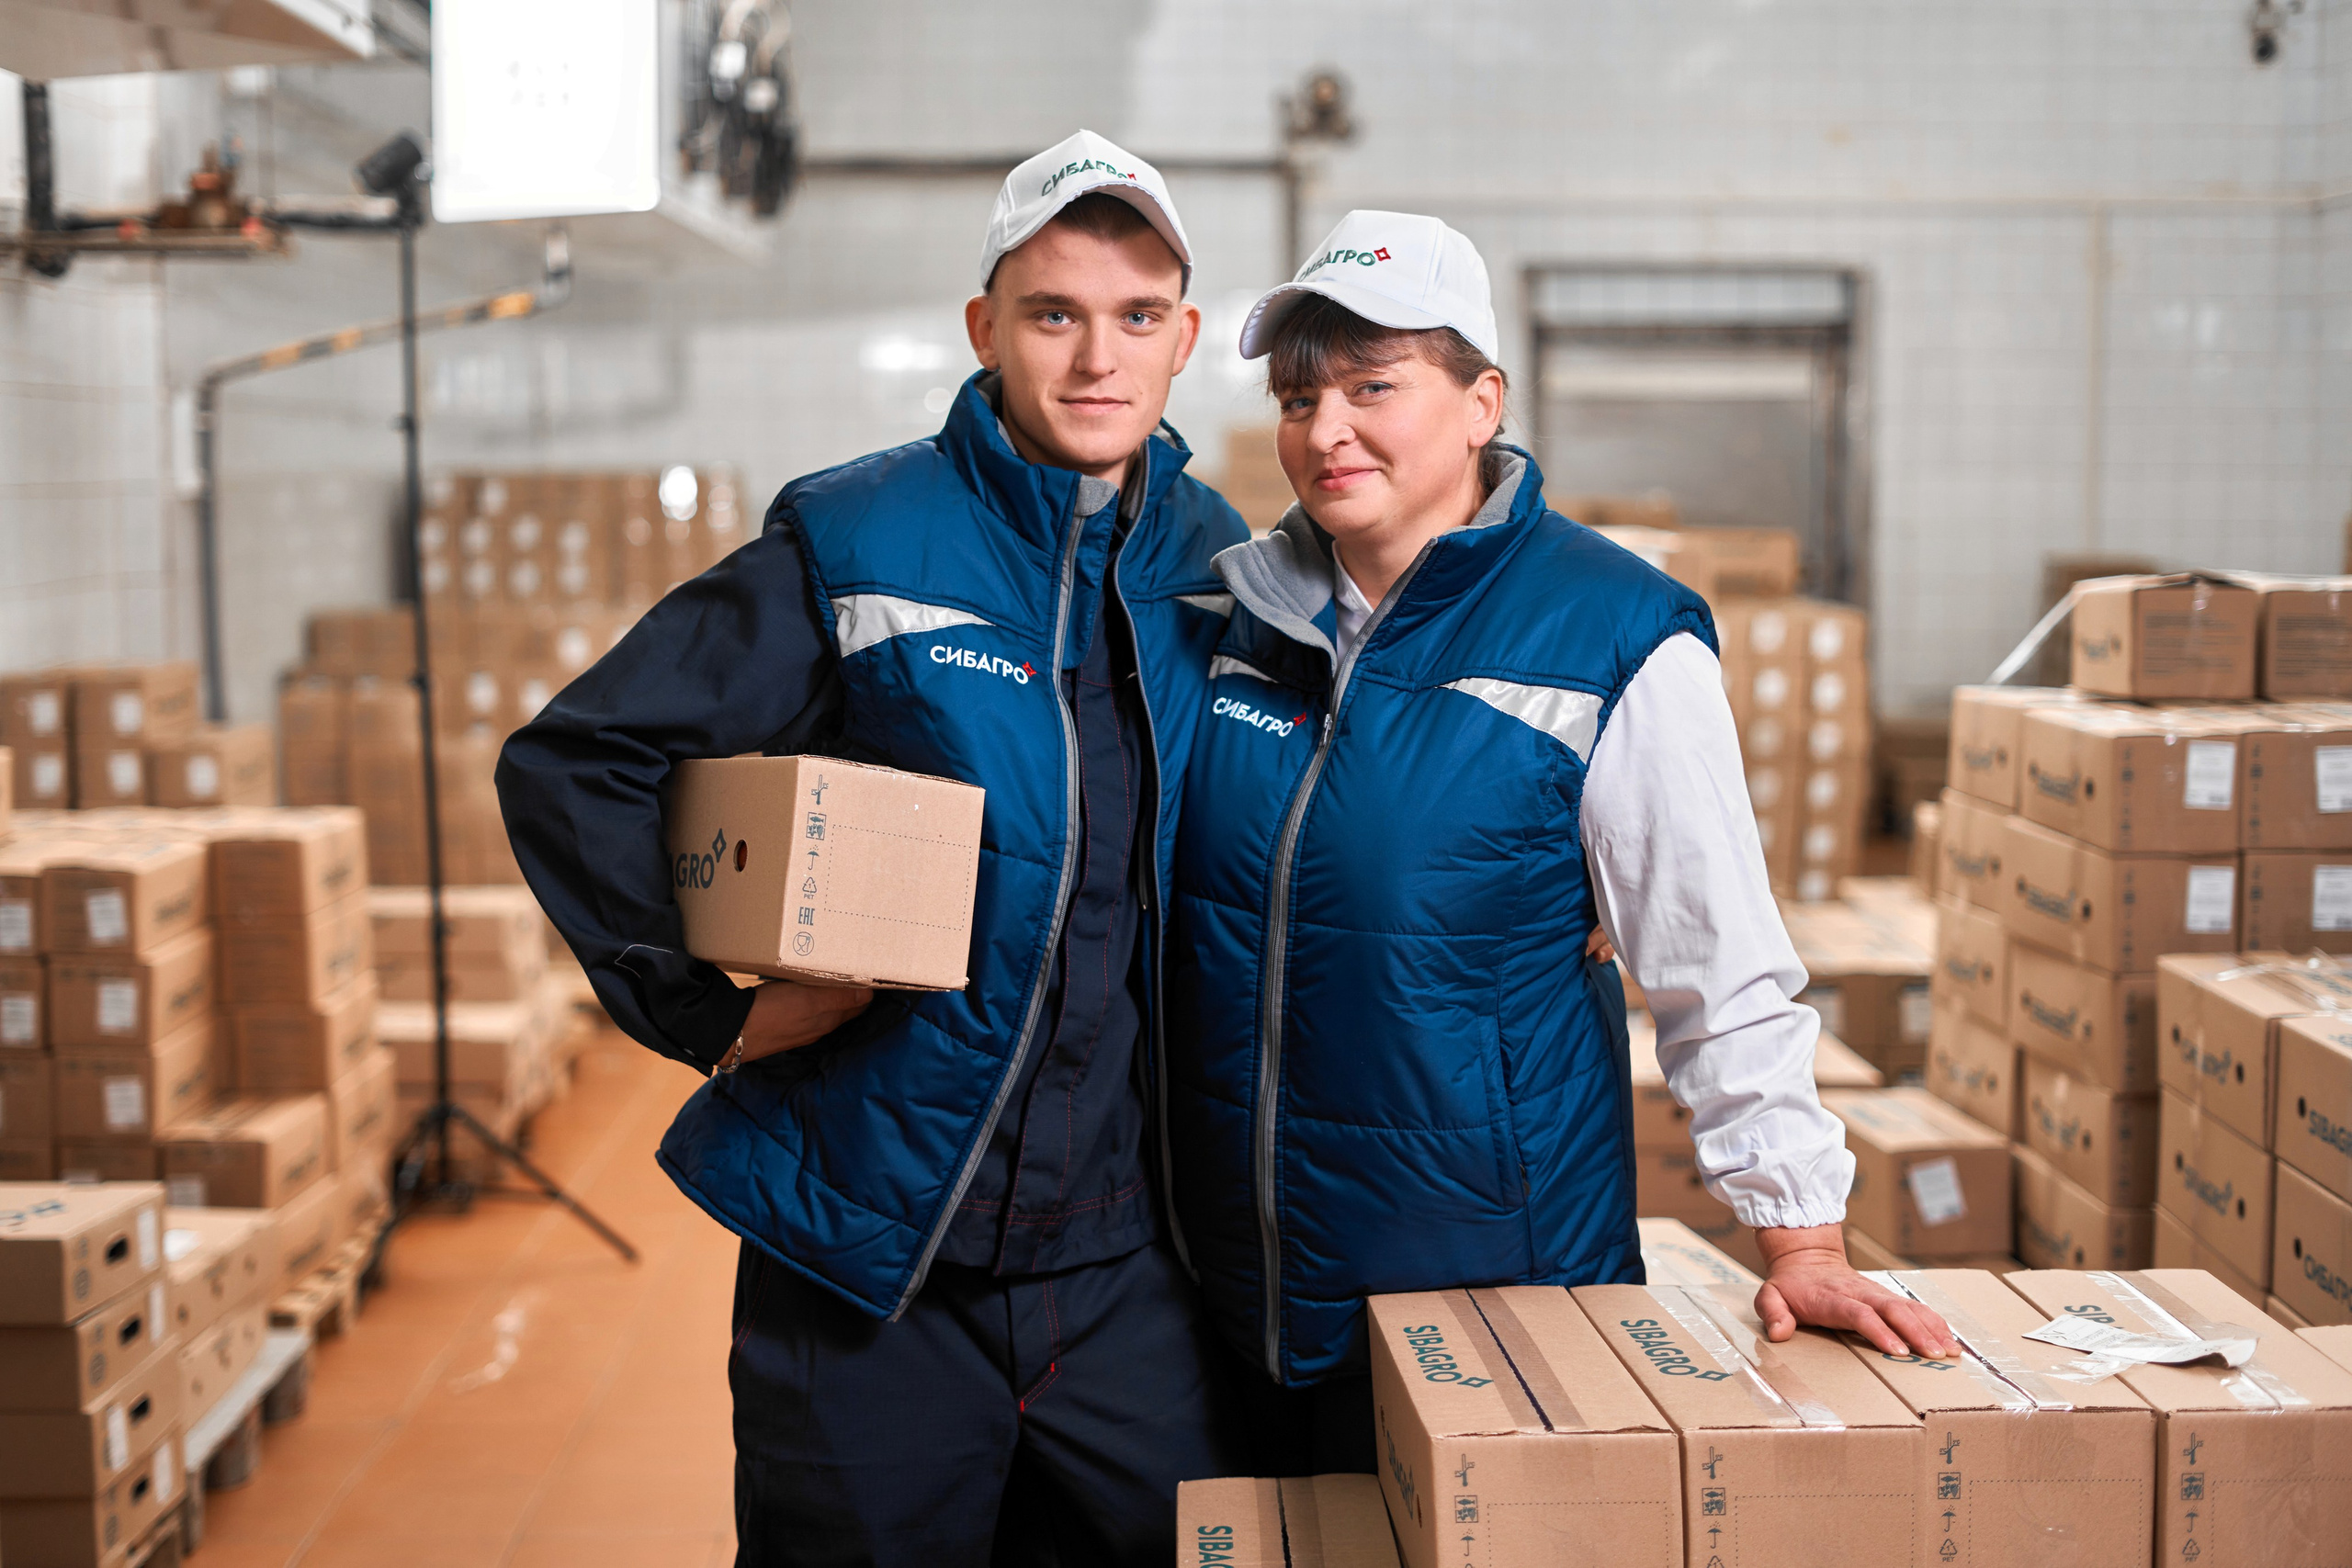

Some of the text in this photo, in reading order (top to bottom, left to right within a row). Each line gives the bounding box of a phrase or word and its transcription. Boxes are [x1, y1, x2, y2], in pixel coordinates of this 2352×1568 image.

[930, 645, 1028, 684] СИБАГРО
[1213, 697, 1294, 737] СИБАГРО
[1403, 1325, 1463, 1382] SIBAGRO
[1620, 1319, 1700, 1375] SIBAGRO
